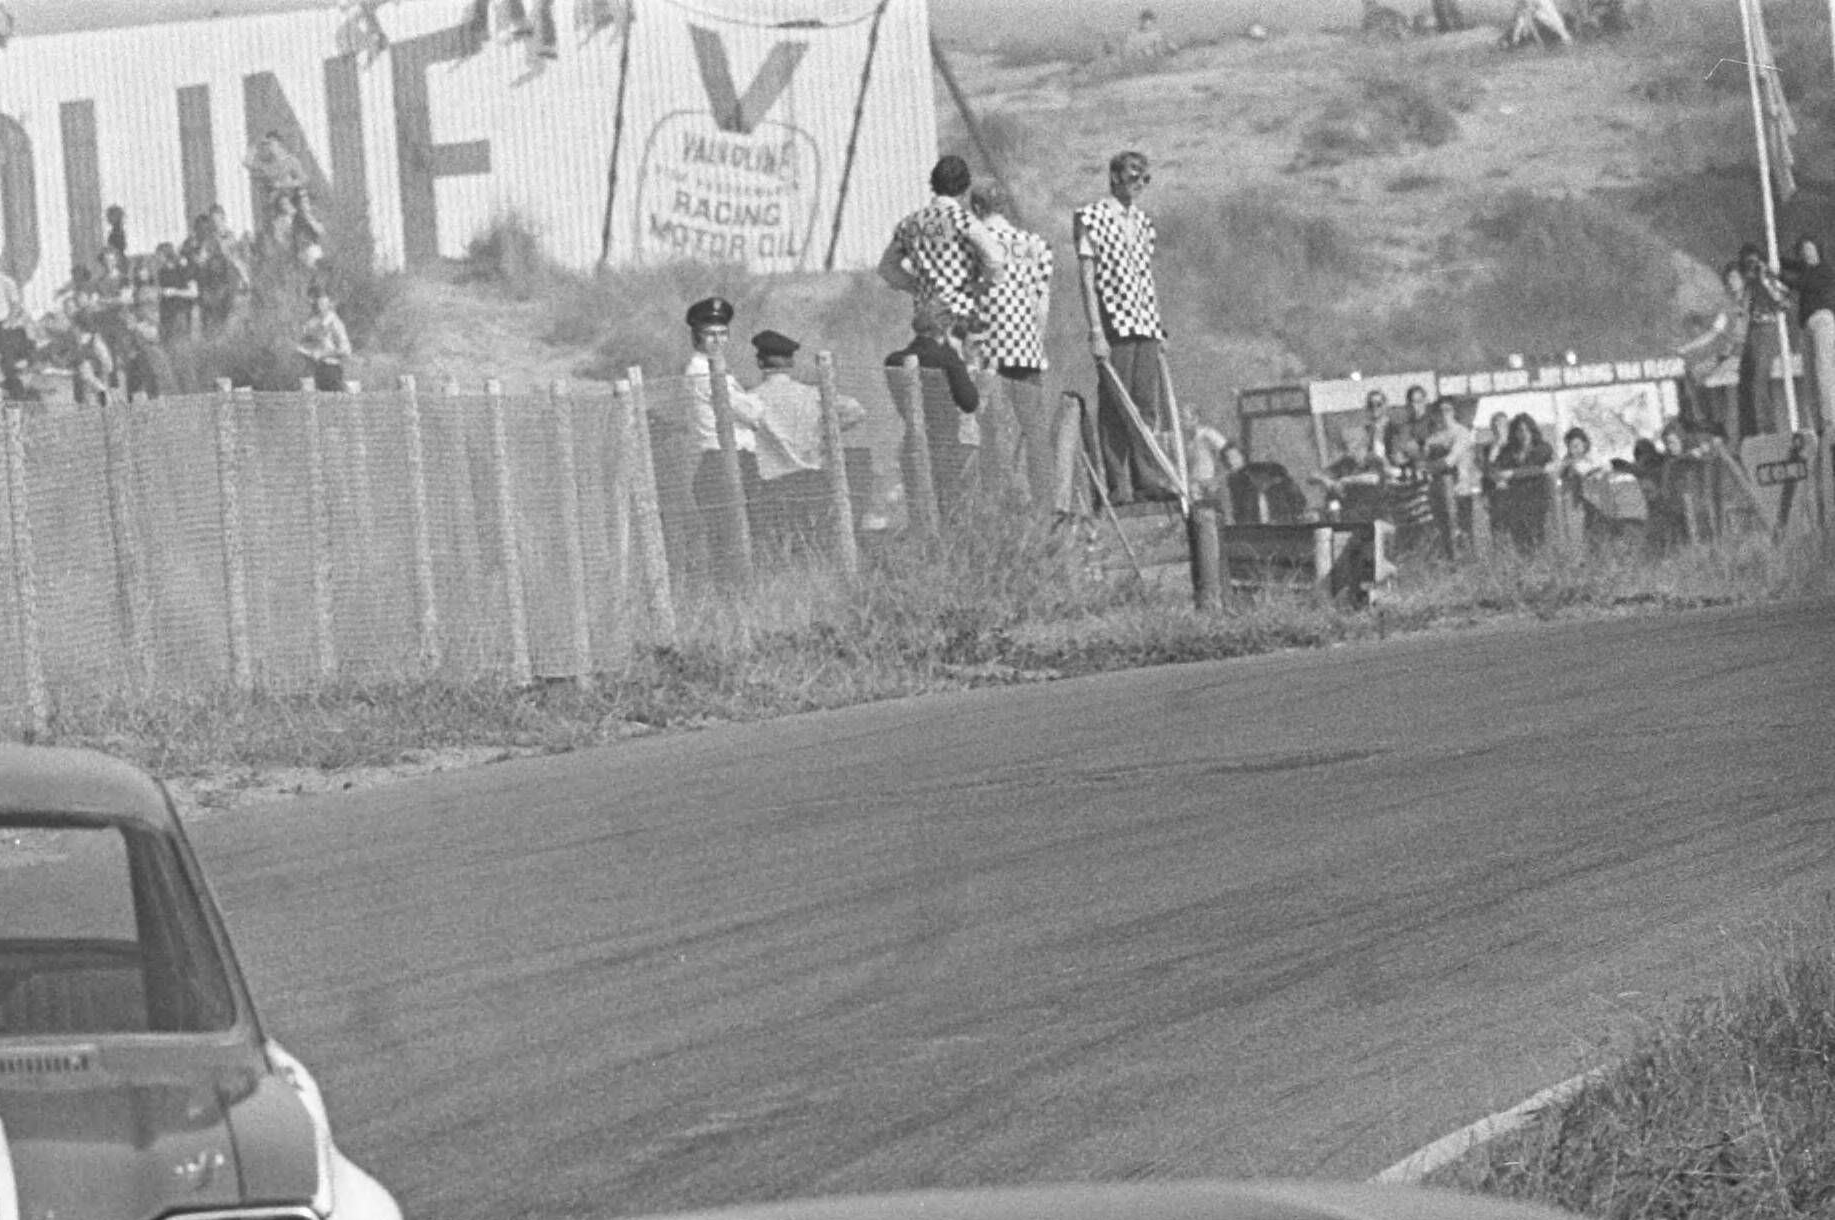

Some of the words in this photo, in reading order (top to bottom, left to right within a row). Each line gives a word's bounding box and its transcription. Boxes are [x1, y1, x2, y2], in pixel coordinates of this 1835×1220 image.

[673, 189, 781, 227] RACING
[648, 213, 746, 259] MOTOR
[758, 225, 798, 258] OIL
